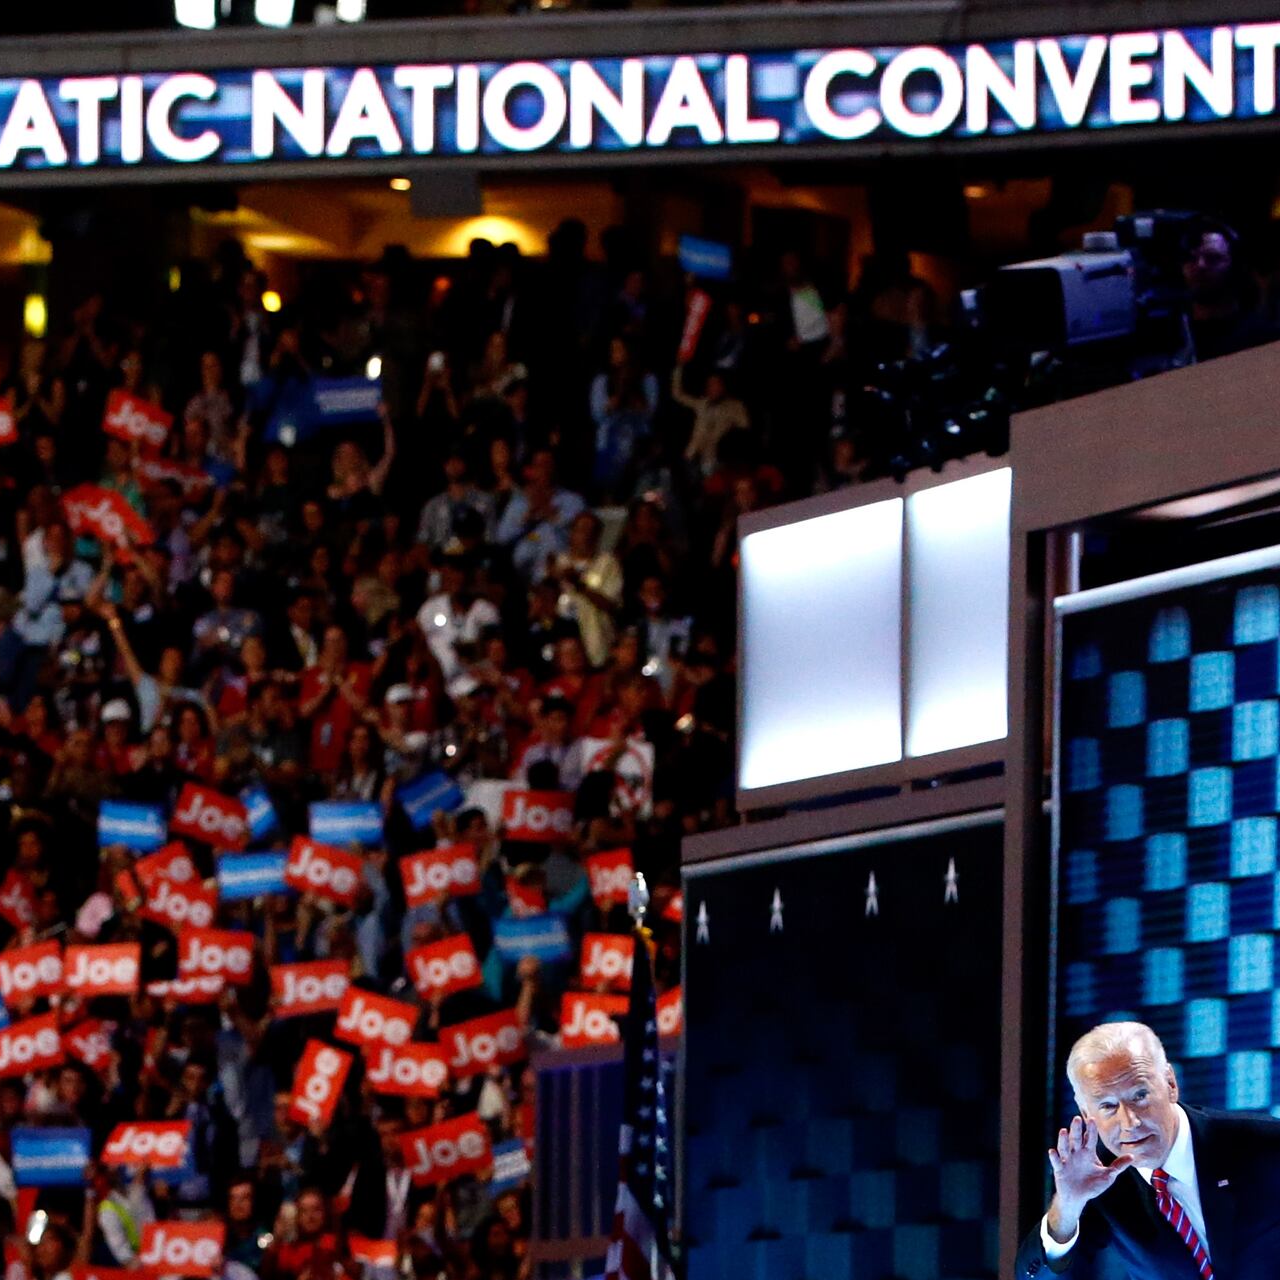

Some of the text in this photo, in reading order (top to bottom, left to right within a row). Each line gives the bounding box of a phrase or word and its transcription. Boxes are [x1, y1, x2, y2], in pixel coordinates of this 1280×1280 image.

[250, 50, 780, 158] NATIONAL
[106, 402, 168, 445] Joe
[177, 792, 245, 840] Joe
[504, 800, 575, 832] Joe
[288, 846, 358, 895] Joe
[405, 857, 479, 899] Joe
[148, 881, 214, 928] Joe
[66, 952, 138, 988] Joe
[177, 936, 253, 976] Joe
[414, 951, 476, 994] Joe
[282, 970, 350, 1006] Joe
[337, 1004, 412, 1048] Joe
[453, 1024, 520, 1068] Joe
[293, 1047, 342, 1124] Joe
[366, 1047, 448, 1087] Joe
[106, 1125, 187, 1156] Joe
[414, 1127, 487, 1174] Joe
[139, 1228, 222, 1266] Joe
